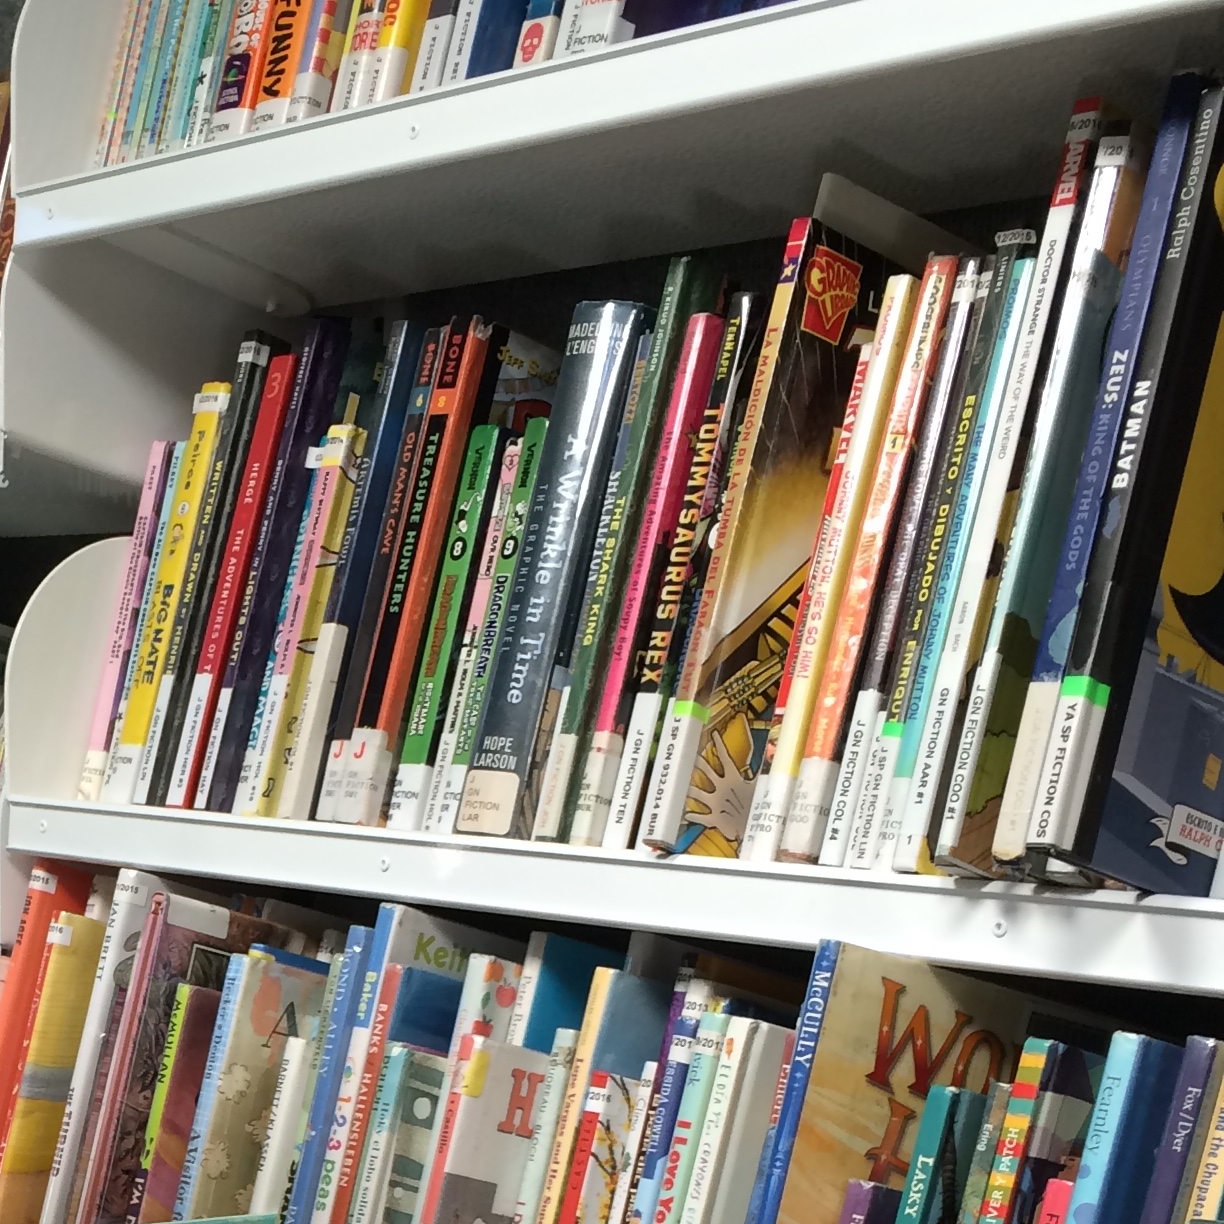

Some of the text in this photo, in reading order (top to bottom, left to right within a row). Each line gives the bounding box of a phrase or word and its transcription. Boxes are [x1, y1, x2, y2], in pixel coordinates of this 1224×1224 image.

[1166, 208, 1192, 260] Ralph
[1180, 107, 1213, 201] Cosentino
[1120, 234, 1151, 331] OLYMPIANS
[717, 316, 741, 381] TENNAPEL
[380, 342, 436, 555] BONE 6 OLD MAN'S CAVE
[389, 334, 462, 613] BONE 8 TREASURE HUNTERS
[948, 394, 976, 479] ESCRITO
[1065, 349, 1129, 571] ZEUS: KING OF THE GODS
[1112, 380, 1152, 490] BATMAN
[202, 460, 224, 525] WRITTEN
[534, 469, 582, 585] Wrinkle
[588, 471, 621, 581] SHACKLETON
[182, 552, 201, 603] DRAWN
[474, 442, 536, 678] VERNON DRAGONBREATH
[500, 484, 548, 653] THE GRAPHIC NOVEL
[582, 497, 626, 646] THE SHARK KING
[640, 403, 726, 684] TOMMYSAURUS REX
[919, 504, 949, 602] DIBUJADO
[156, 583, 175, 623] BIG
[207, 528, 245, 658] THE ADVENTURES OF
[526, 596, 550, 622] in
[912, 609, 923, 631] POR
[141, 628, 166, 685] NATE
[507, 632, 546, 704] Time
[473, 753, 517, 769] LARSON
[483, 736, 513, 751] HOPE
[616, 739, 643, 824] GN FICTION TEN
[913, 687, 950, 805] GN FICTION AAR #1
[945, 696, 984, 821] GN FICTION COO #1
[1036, 702, 1078, 839] YA SP FICTION COS
[465, 797, 500, 811] FICTION
[829, 731, 864, 841] GN FICTION COL #4
[1179, 824, 1211, 847] RALPH
[16, 895, 32, 946] JON AGEE
[107, 902, 119, 929] JAN
[96, 935, 112, 982] BRETT
[335, 948, 354, 1000] BOND
[357, 971, 378, 1020] Baker
[794, 970, 831, 1069] McCULLY
[130, 999, 183, 1204] McMULLAN I'M
[338, 1004, 388, 1188] BANKS HALLENSLEBEN
[437, 1107, 455, 1154] Castillo
[497, 1067, 546, 1139] H
[1087, 1075, 1121, 1156] Fearnley
[975, 1123, 993, 1152] Ering
[999, 1127, 1019, 1173] PATCH
[316, 1159, 336, 1212] peas
[903, 1155, 934, 1219] LASKY
